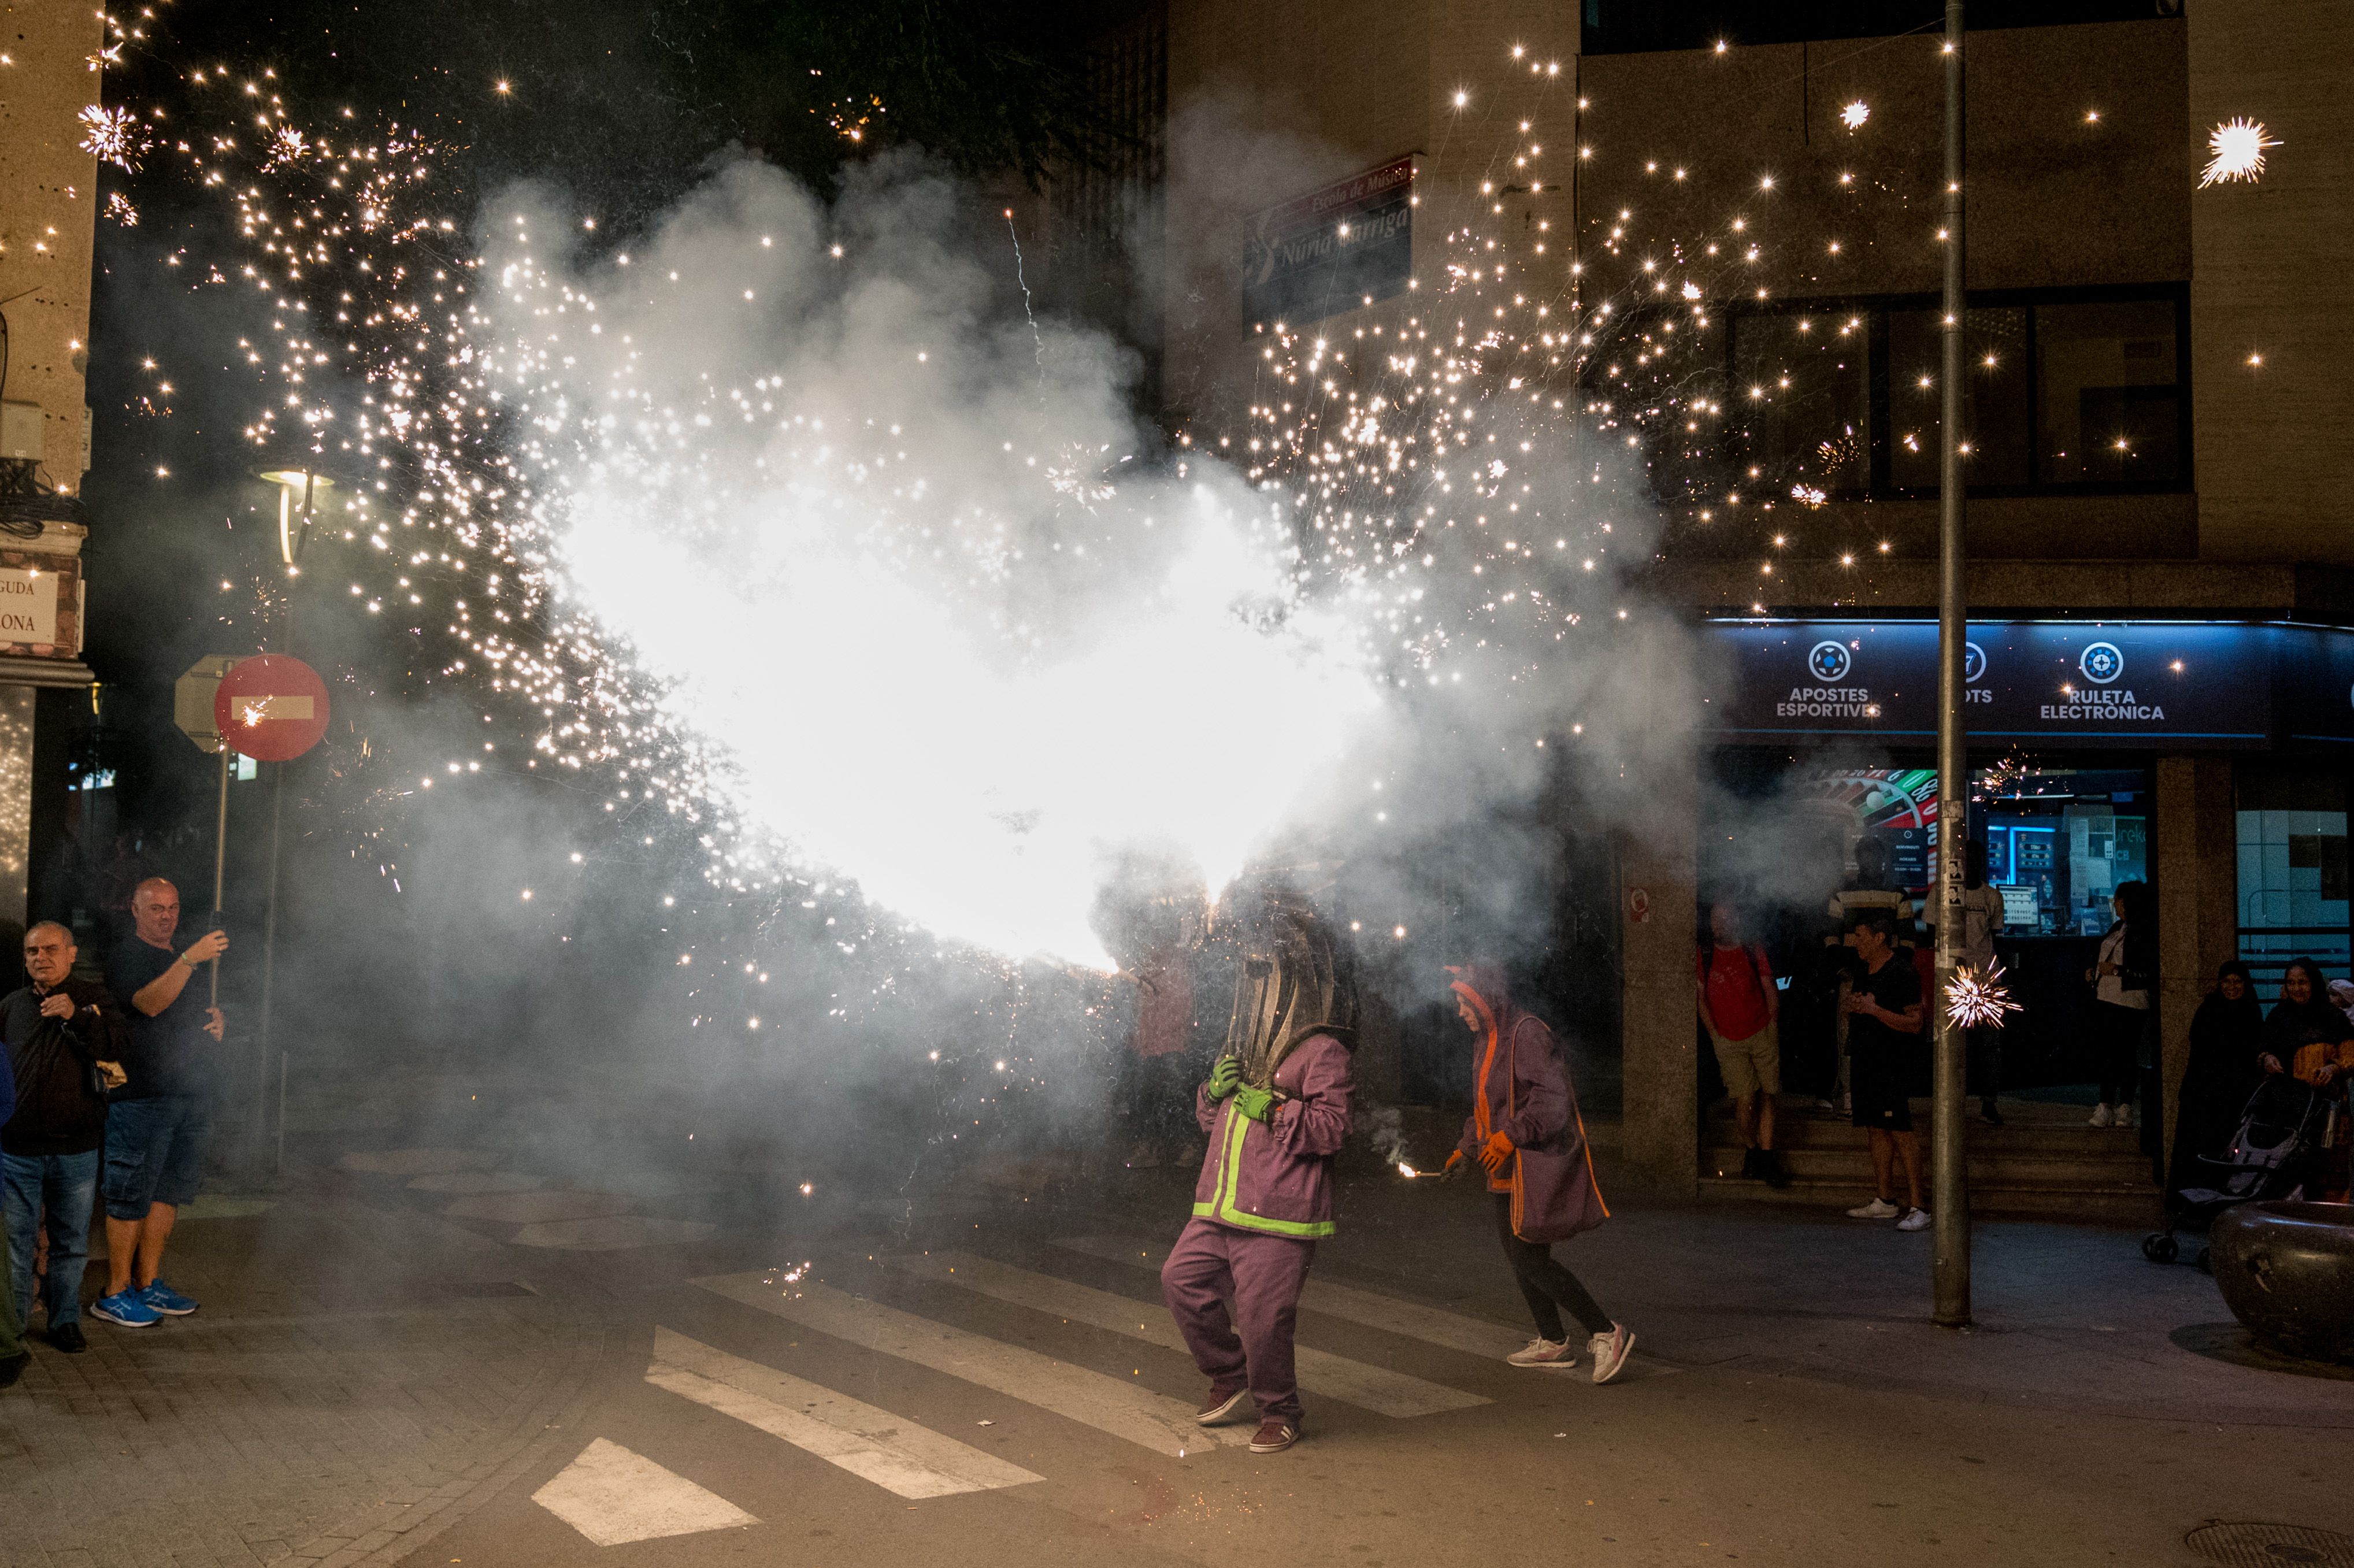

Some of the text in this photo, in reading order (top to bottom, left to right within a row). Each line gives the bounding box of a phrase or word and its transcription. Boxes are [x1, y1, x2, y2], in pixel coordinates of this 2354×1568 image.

[1313, 168, 1408, 212] Escola de Música
[1282, 232, 1331, 266] Núria
[0, 614, 35, 631] ONA
[1789, 688, 1869, 702] APOSTES
[2069, 690, 2136, 704] RULETA
[1777, 703, 1881, 717] ESPORTIVES
[2040, 702, 2164, 720] ELECTRÒNICA
